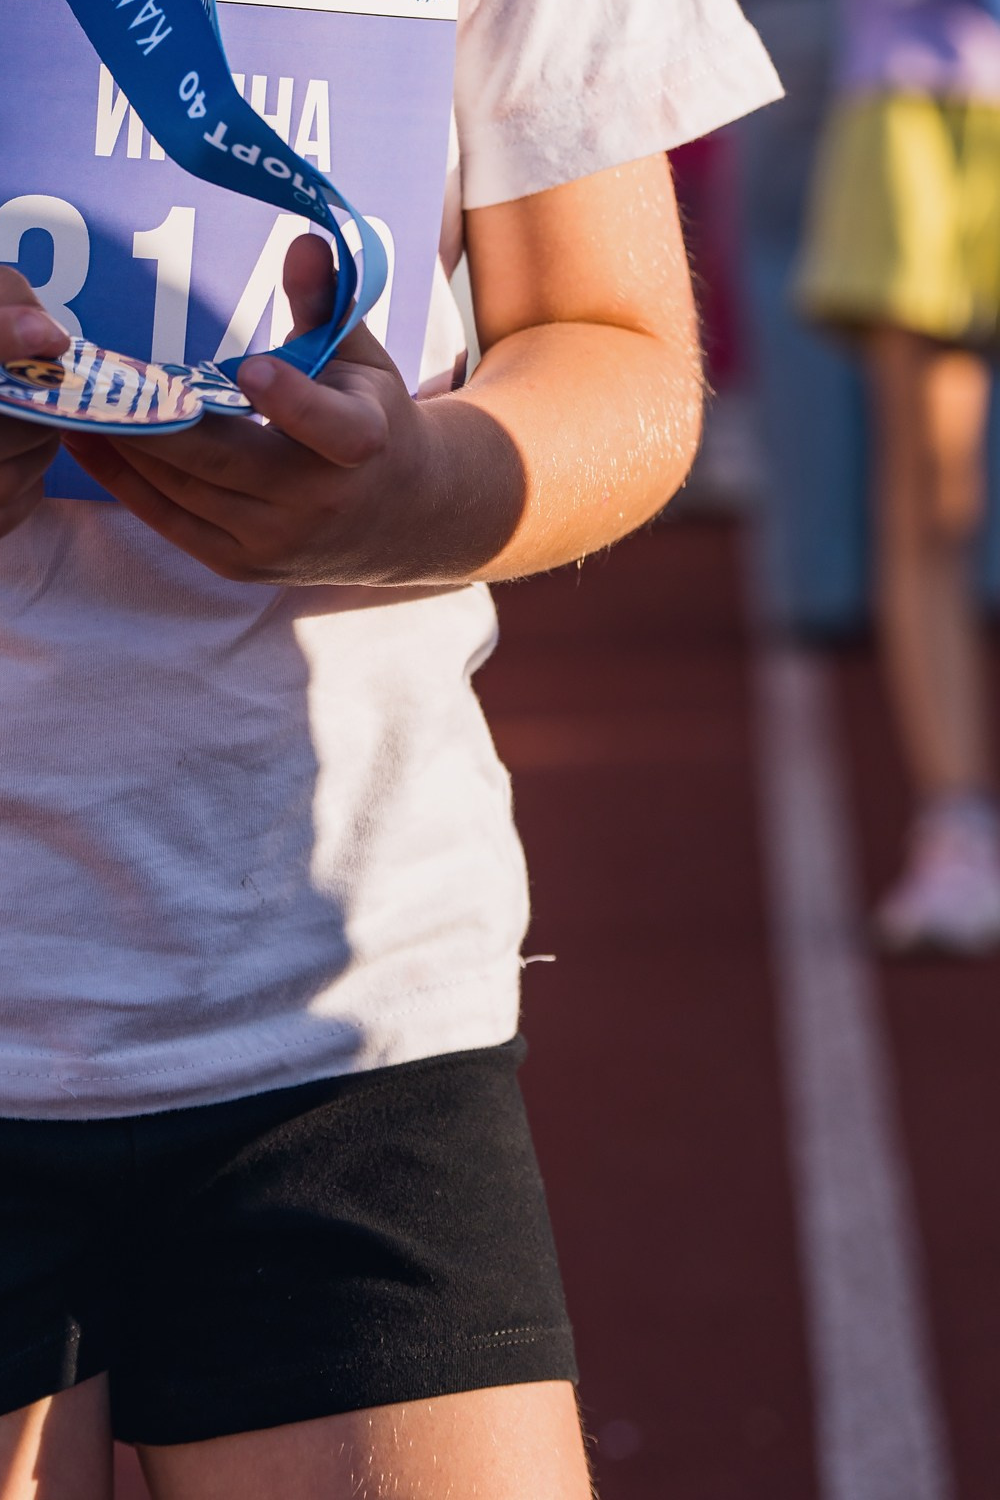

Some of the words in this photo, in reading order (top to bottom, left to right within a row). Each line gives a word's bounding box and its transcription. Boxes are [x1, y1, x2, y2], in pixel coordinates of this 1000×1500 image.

[95, 62, 331, 173] ИНА
[179, 71, 206, 119] 40
[203, 121, 317, 200] ПОРТ
